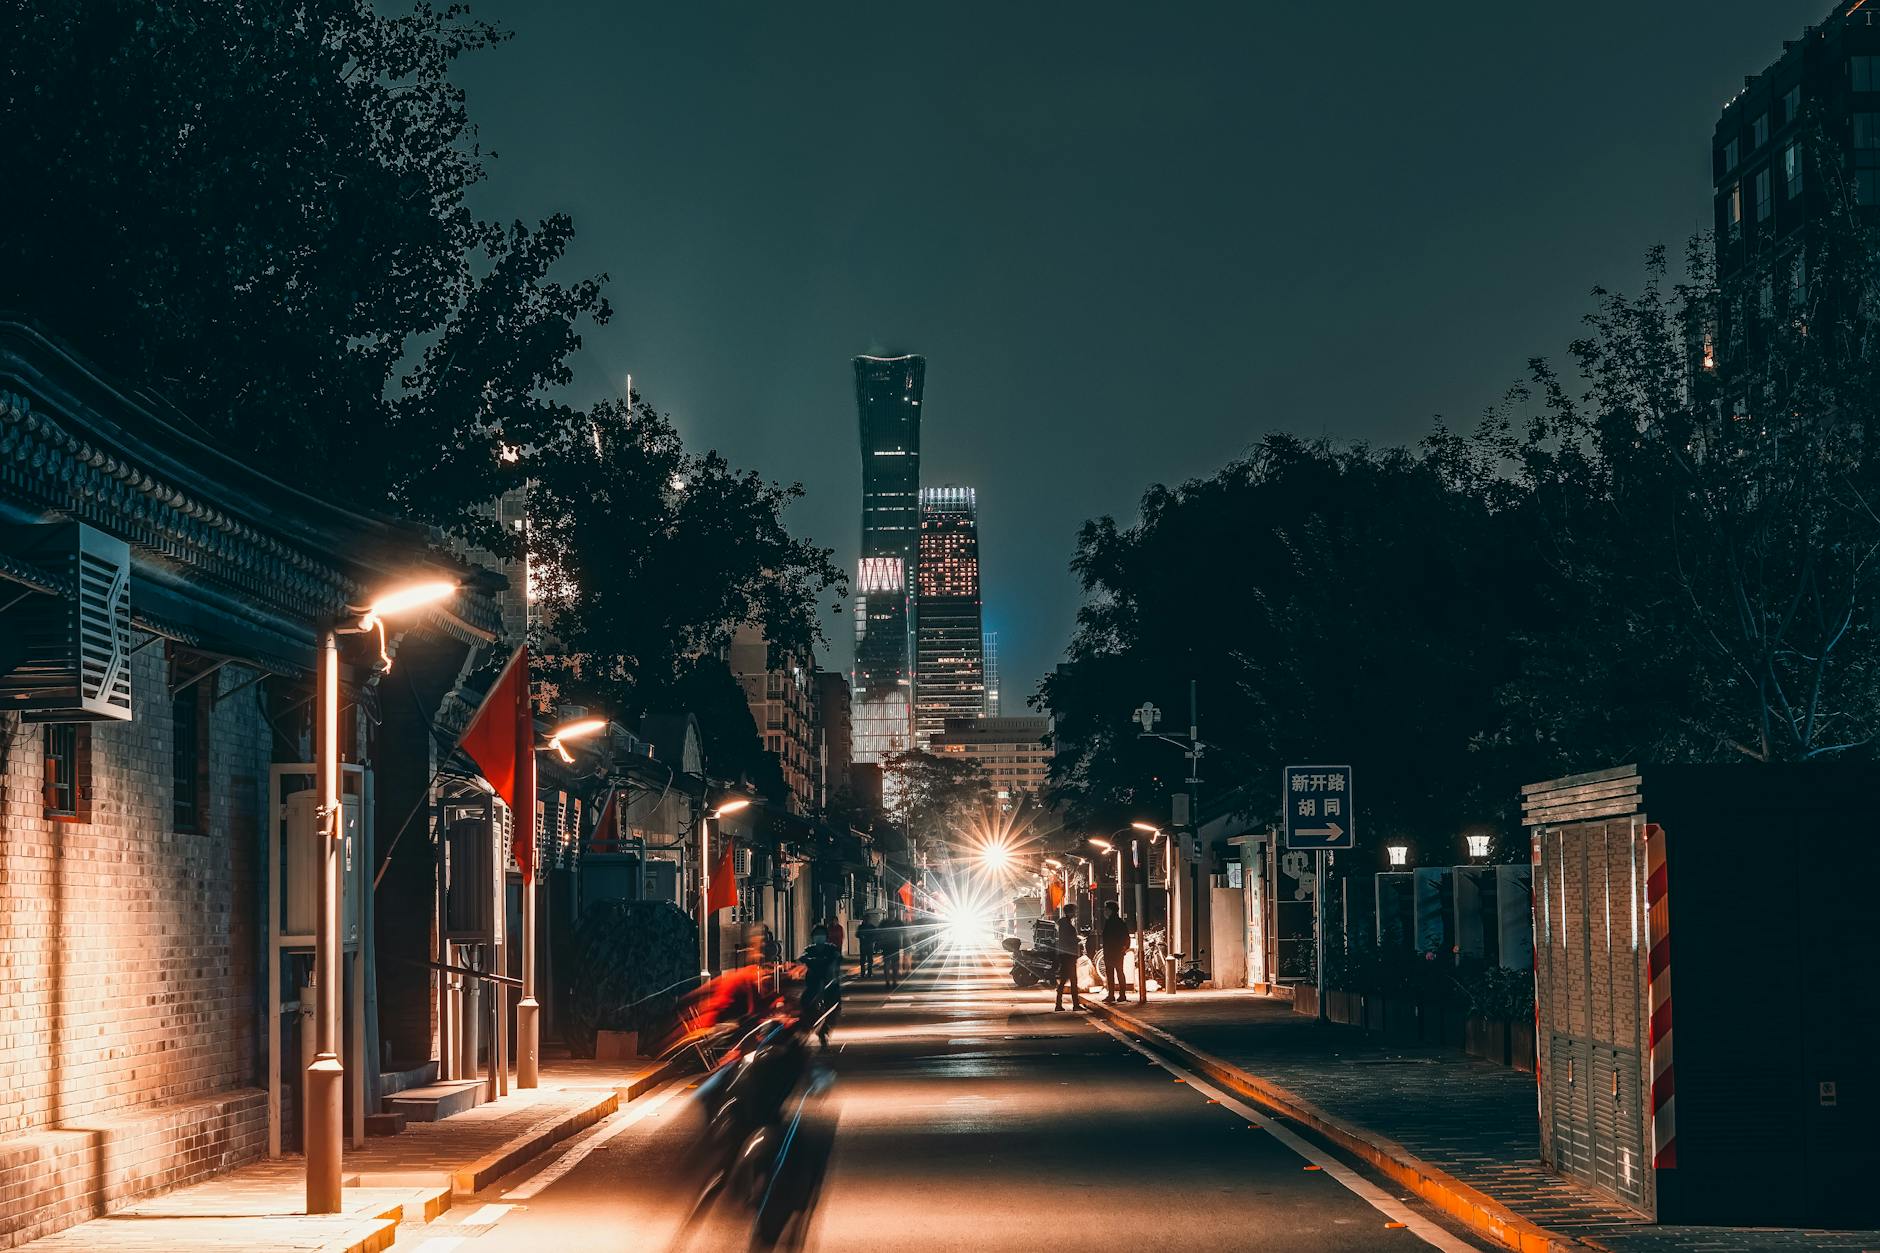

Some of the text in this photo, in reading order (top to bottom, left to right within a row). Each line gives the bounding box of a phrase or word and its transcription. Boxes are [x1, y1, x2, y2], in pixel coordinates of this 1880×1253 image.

[1291, 773, 1345, 792] 新开路
[1298, 799, 1341, 817] 胡同
